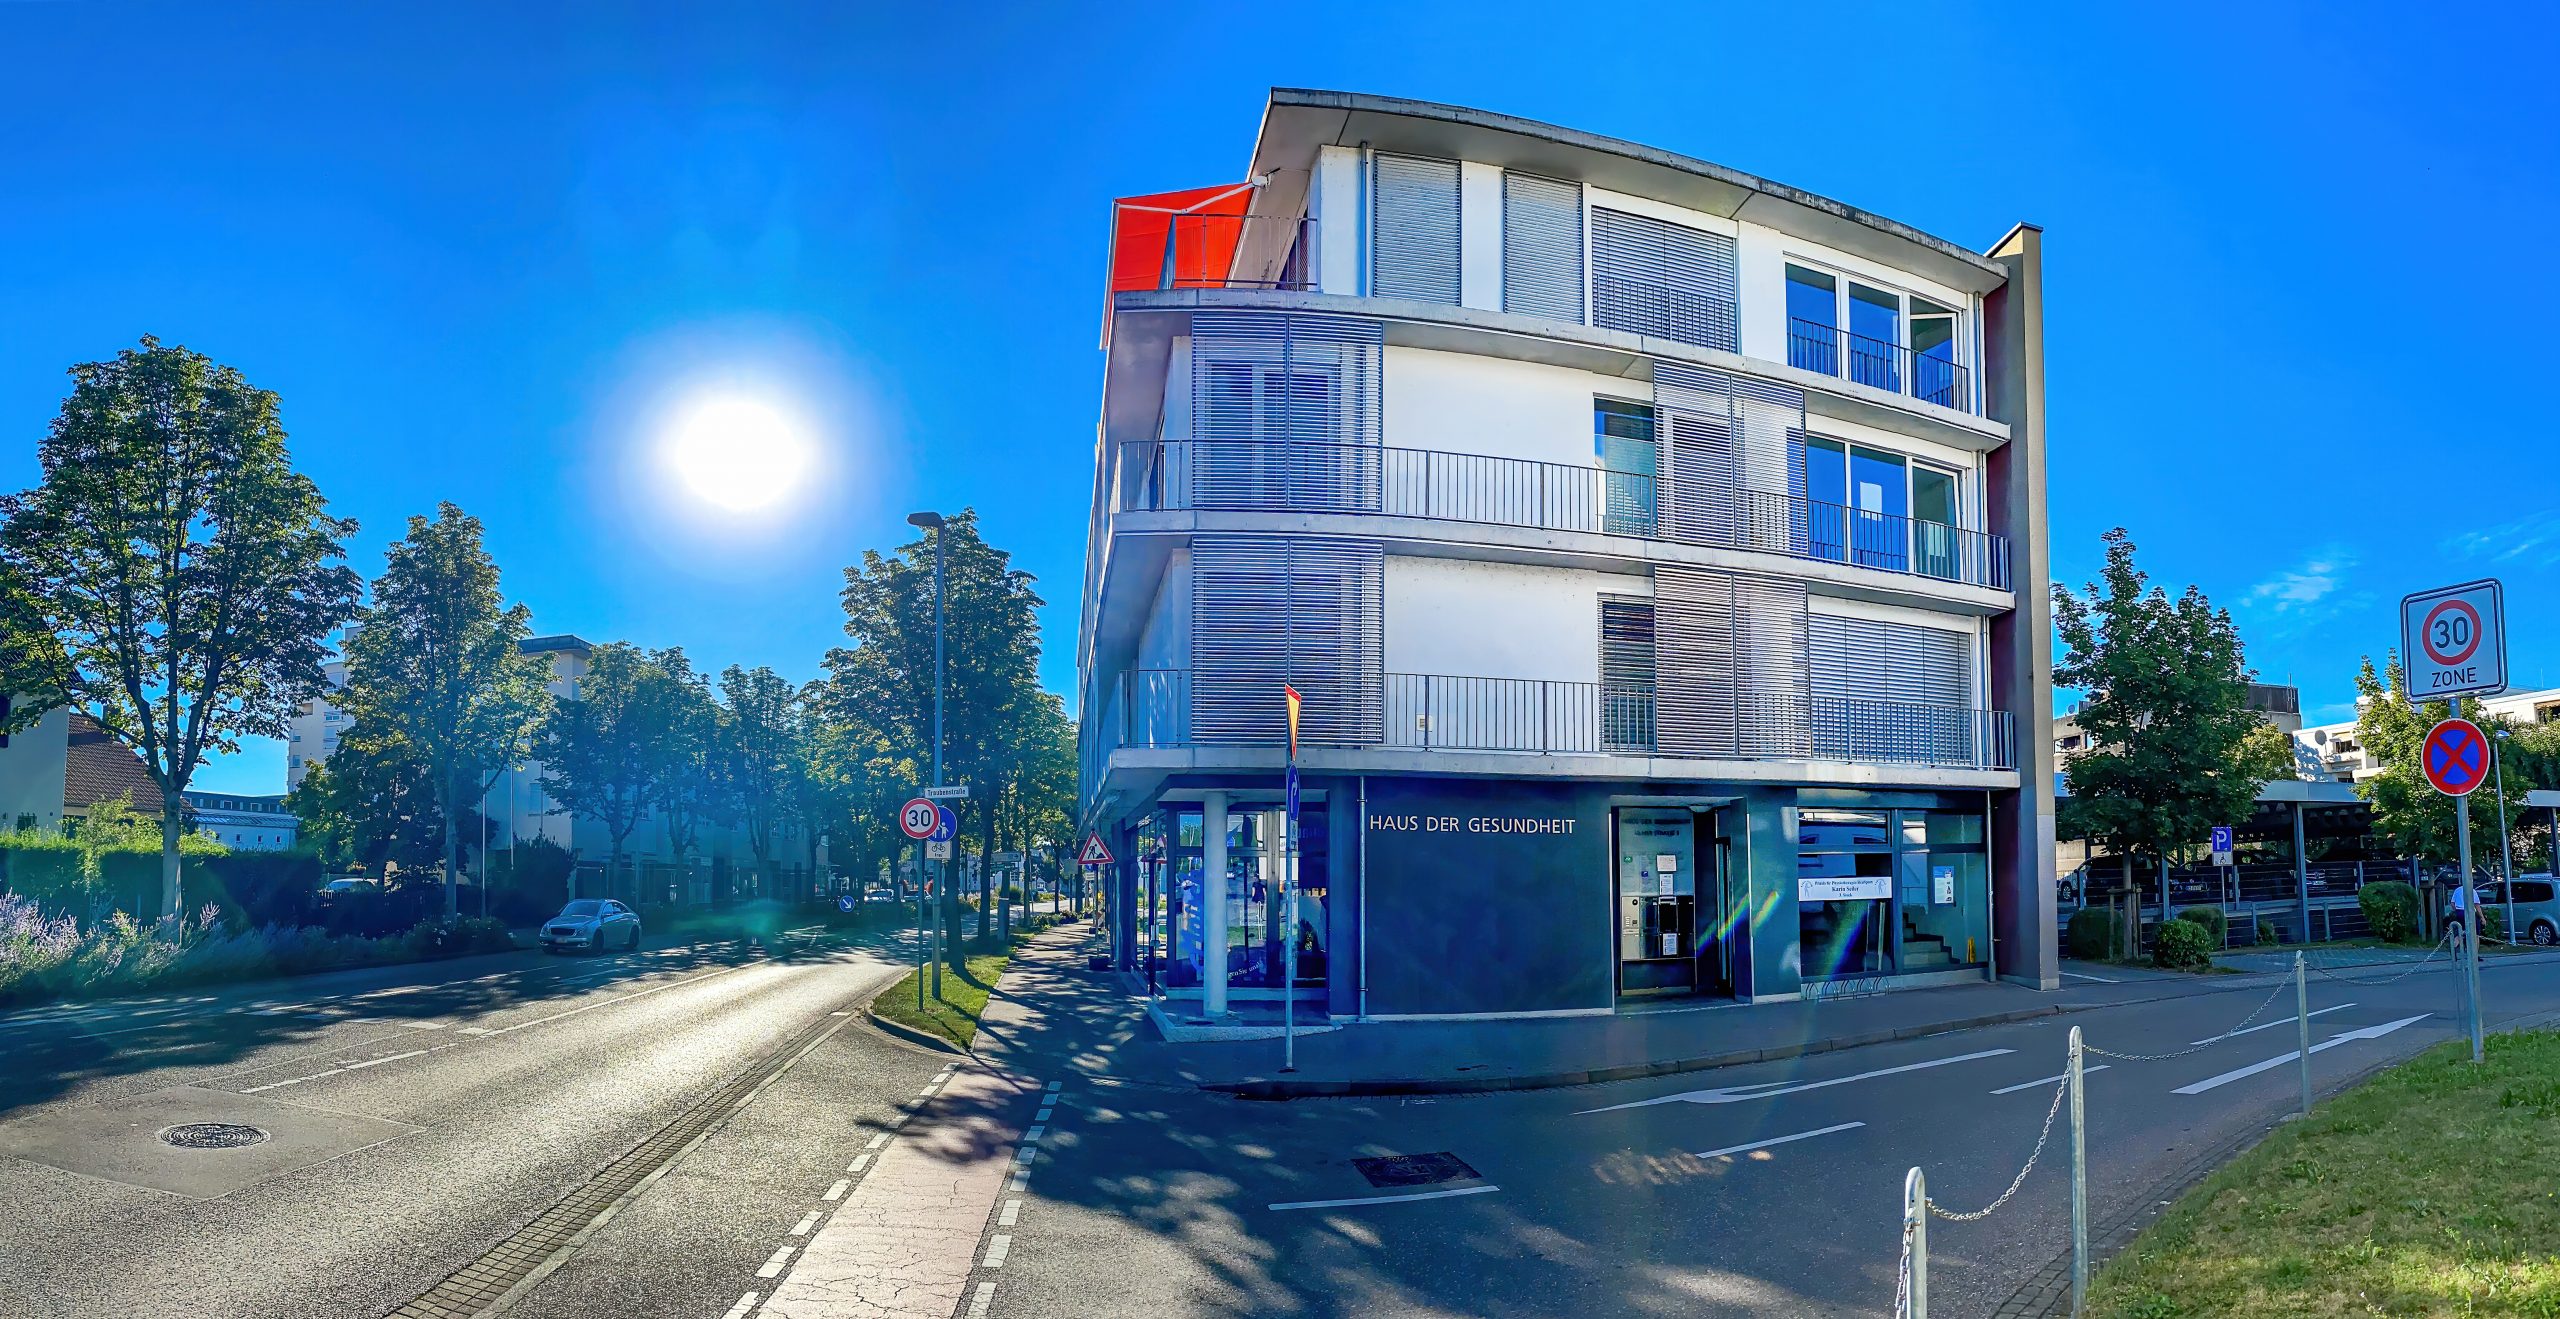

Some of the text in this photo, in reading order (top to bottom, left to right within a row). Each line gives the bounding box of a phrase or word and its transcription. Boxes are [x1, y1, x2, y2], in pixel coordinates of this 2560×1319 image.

[2434, 616, 2469, 649] 30
[2431, 666, 2477, 688] ZONE
[908, 809, 931, 827] 30
[1369, 815, 1576, 834] HAUS DER GESUNDHEIT
[2216, 830, 2227, 850] P
